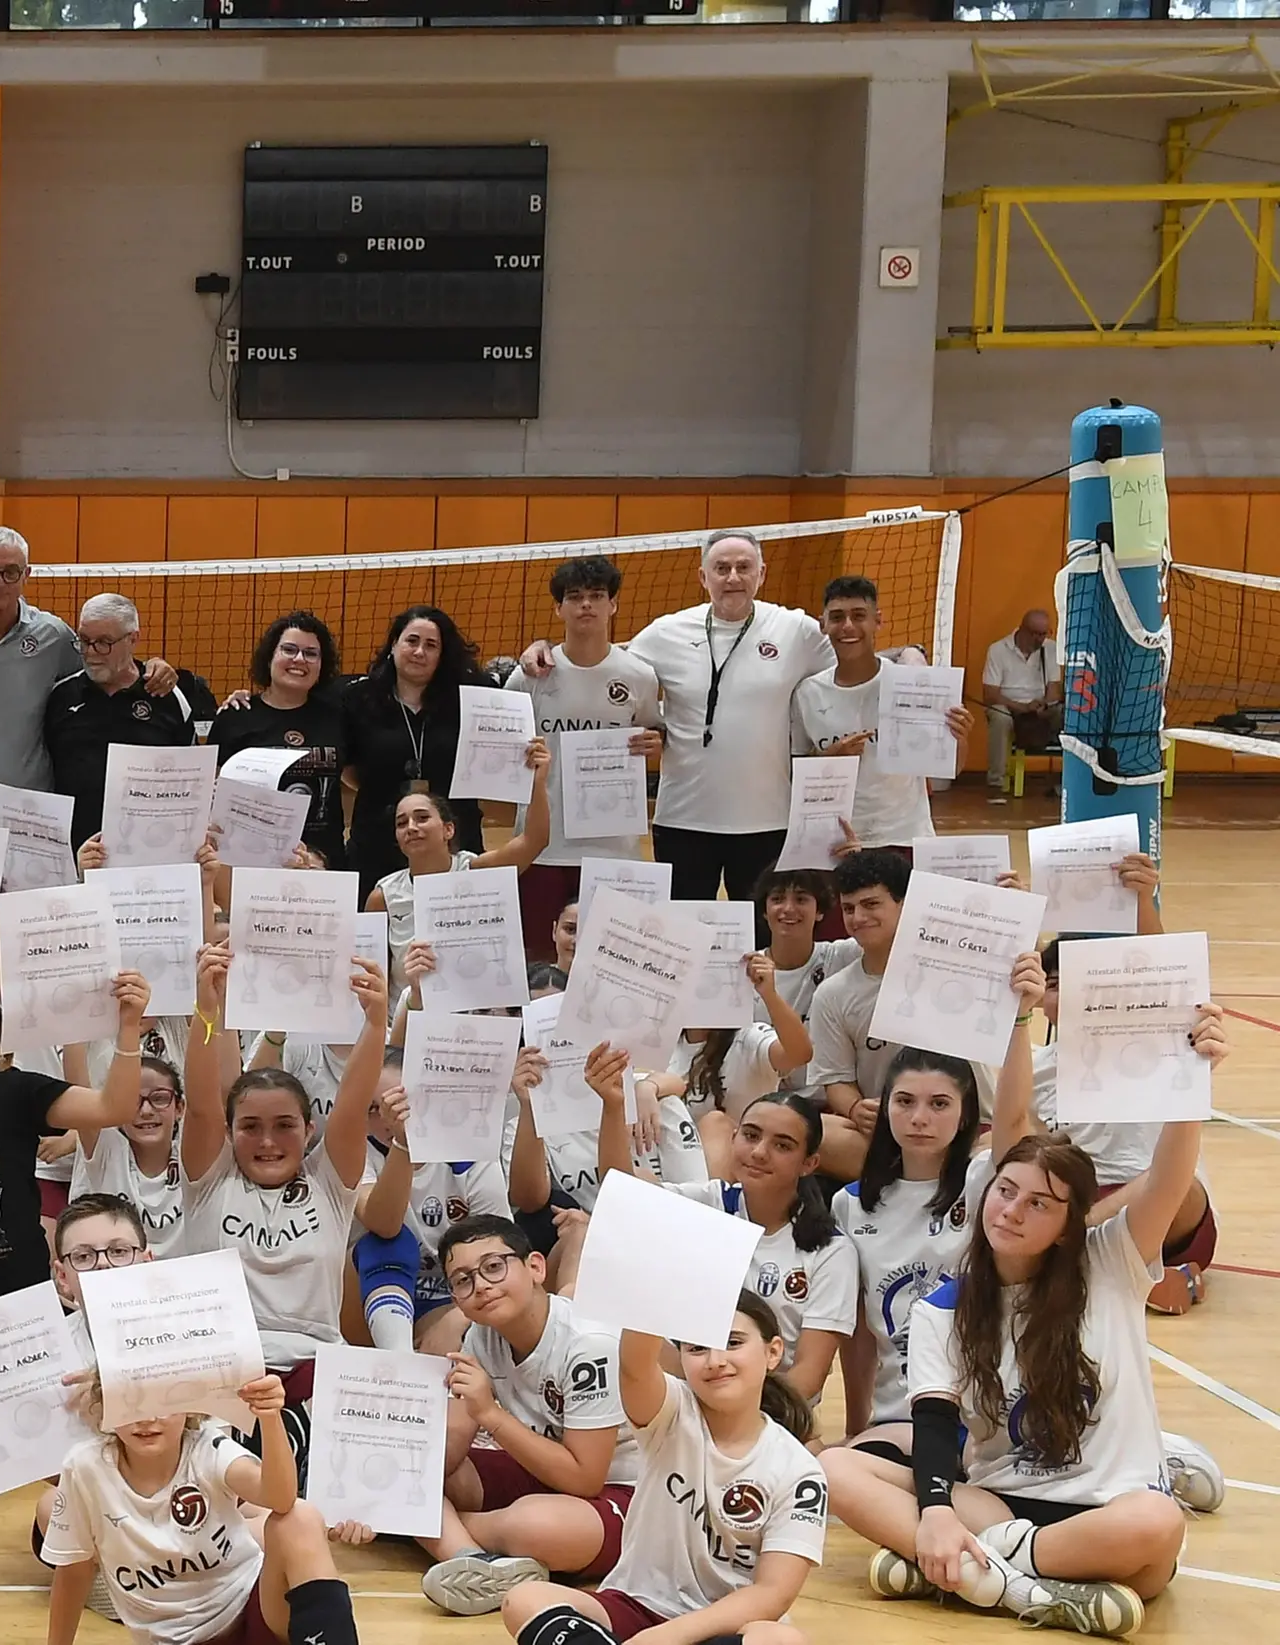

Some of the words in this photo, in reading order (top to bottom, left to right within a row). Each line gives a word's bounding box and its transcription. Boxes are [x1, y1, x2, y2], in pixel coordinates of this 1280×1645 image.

[351, 195, 363, 213] B
[530, 194, 542, 212] B
[366, 237, 426, 251] PERIOD
[246, 256, 293, 269] T.OUT
[494, 254, 541, 268] T.OUT
[247, 347, 298, 360] FOULS
[482, 346, 534, 359] FOULS
[872, 510, 918, 525] KIPSTA
[1138, 500, 1153, 533] 4
[222, 1206, 321, 1250] CANALE
[111, 1298, 148, 1310] Attestato
[158, 1286, 220, 1304] partecipazione
[338, 1373, 370, 1383] Attestato
[378, 1378, 429, 1391] partecipazione
[115, 1525, 230, 1594] CANALE
